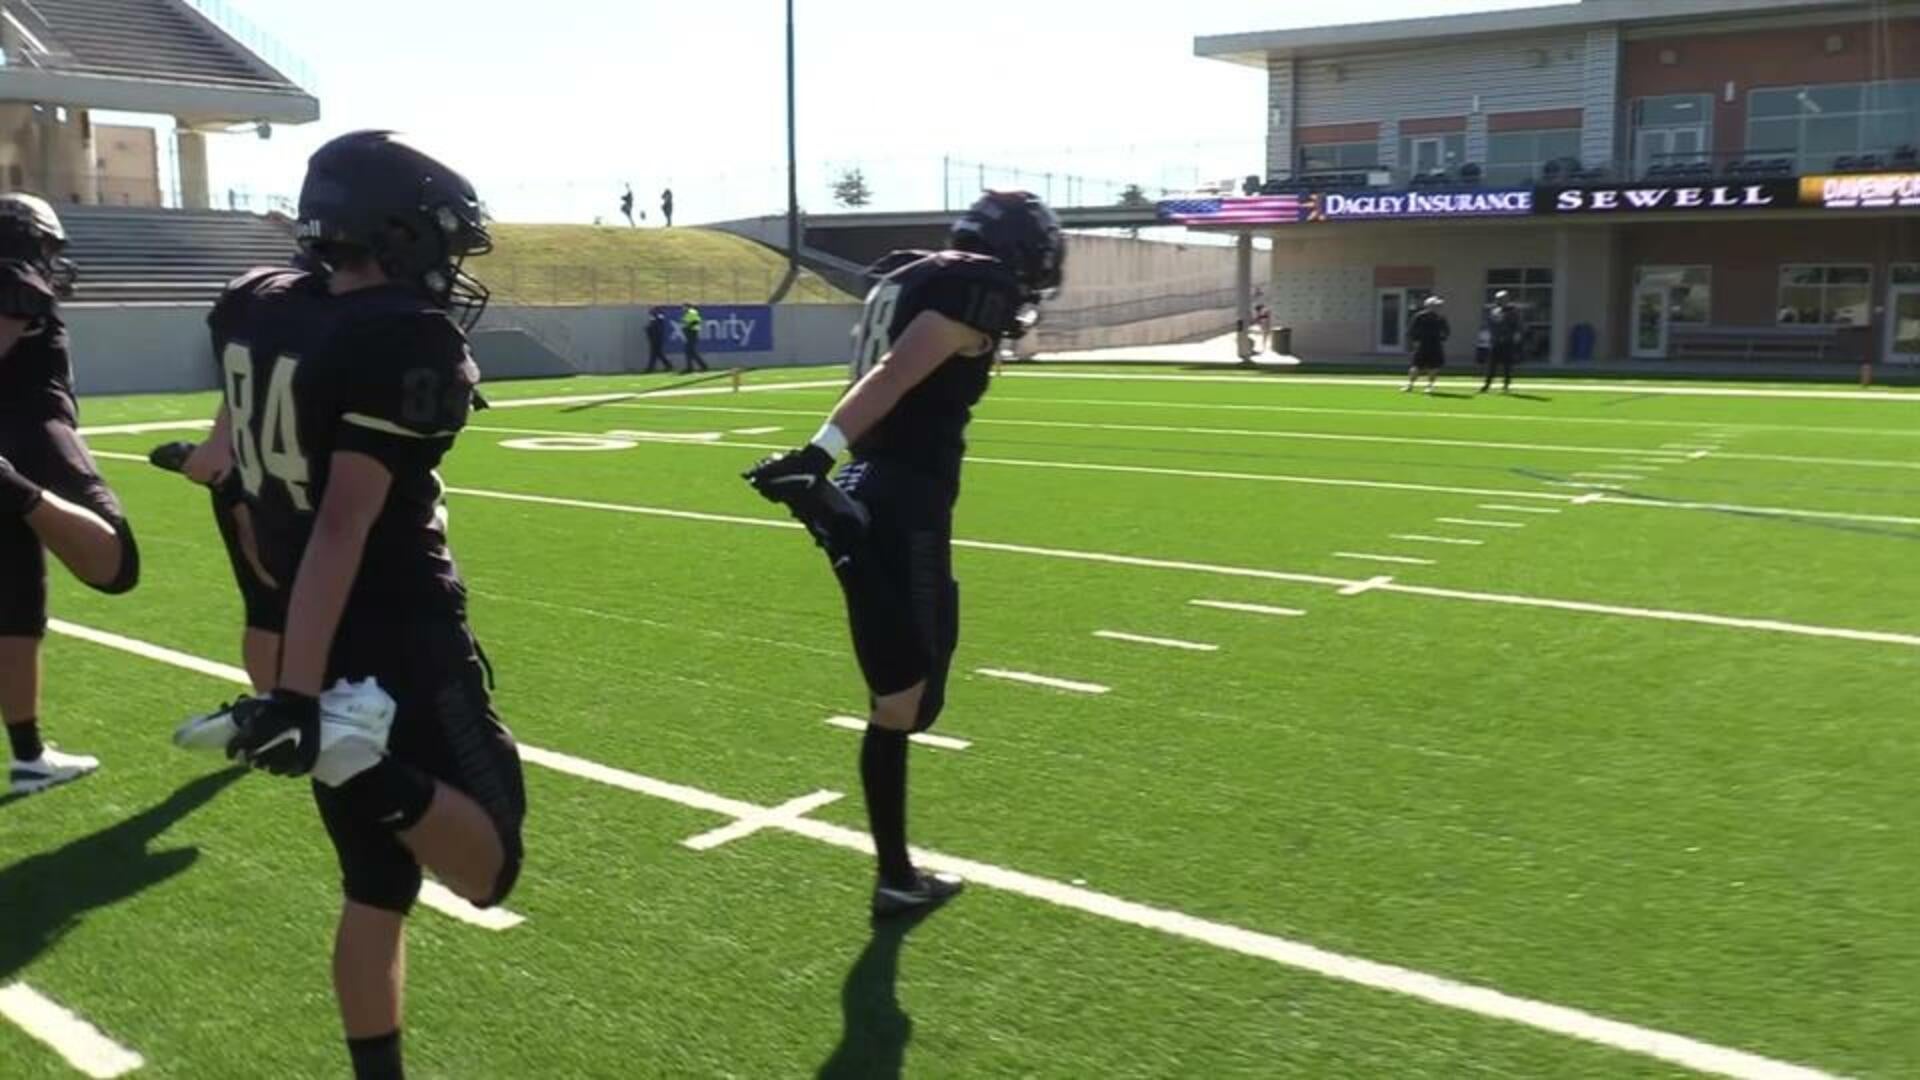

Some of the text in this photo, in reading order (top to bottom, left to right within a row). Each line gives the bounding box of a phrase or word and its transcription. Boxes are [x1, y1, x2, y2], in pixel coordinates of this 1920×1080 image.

[1326, 191, 1531, 214] DAGLEY INSURANCE
[1556, 186, 1773, 209] SEWELL
[223, 341, 313, 510] 84
